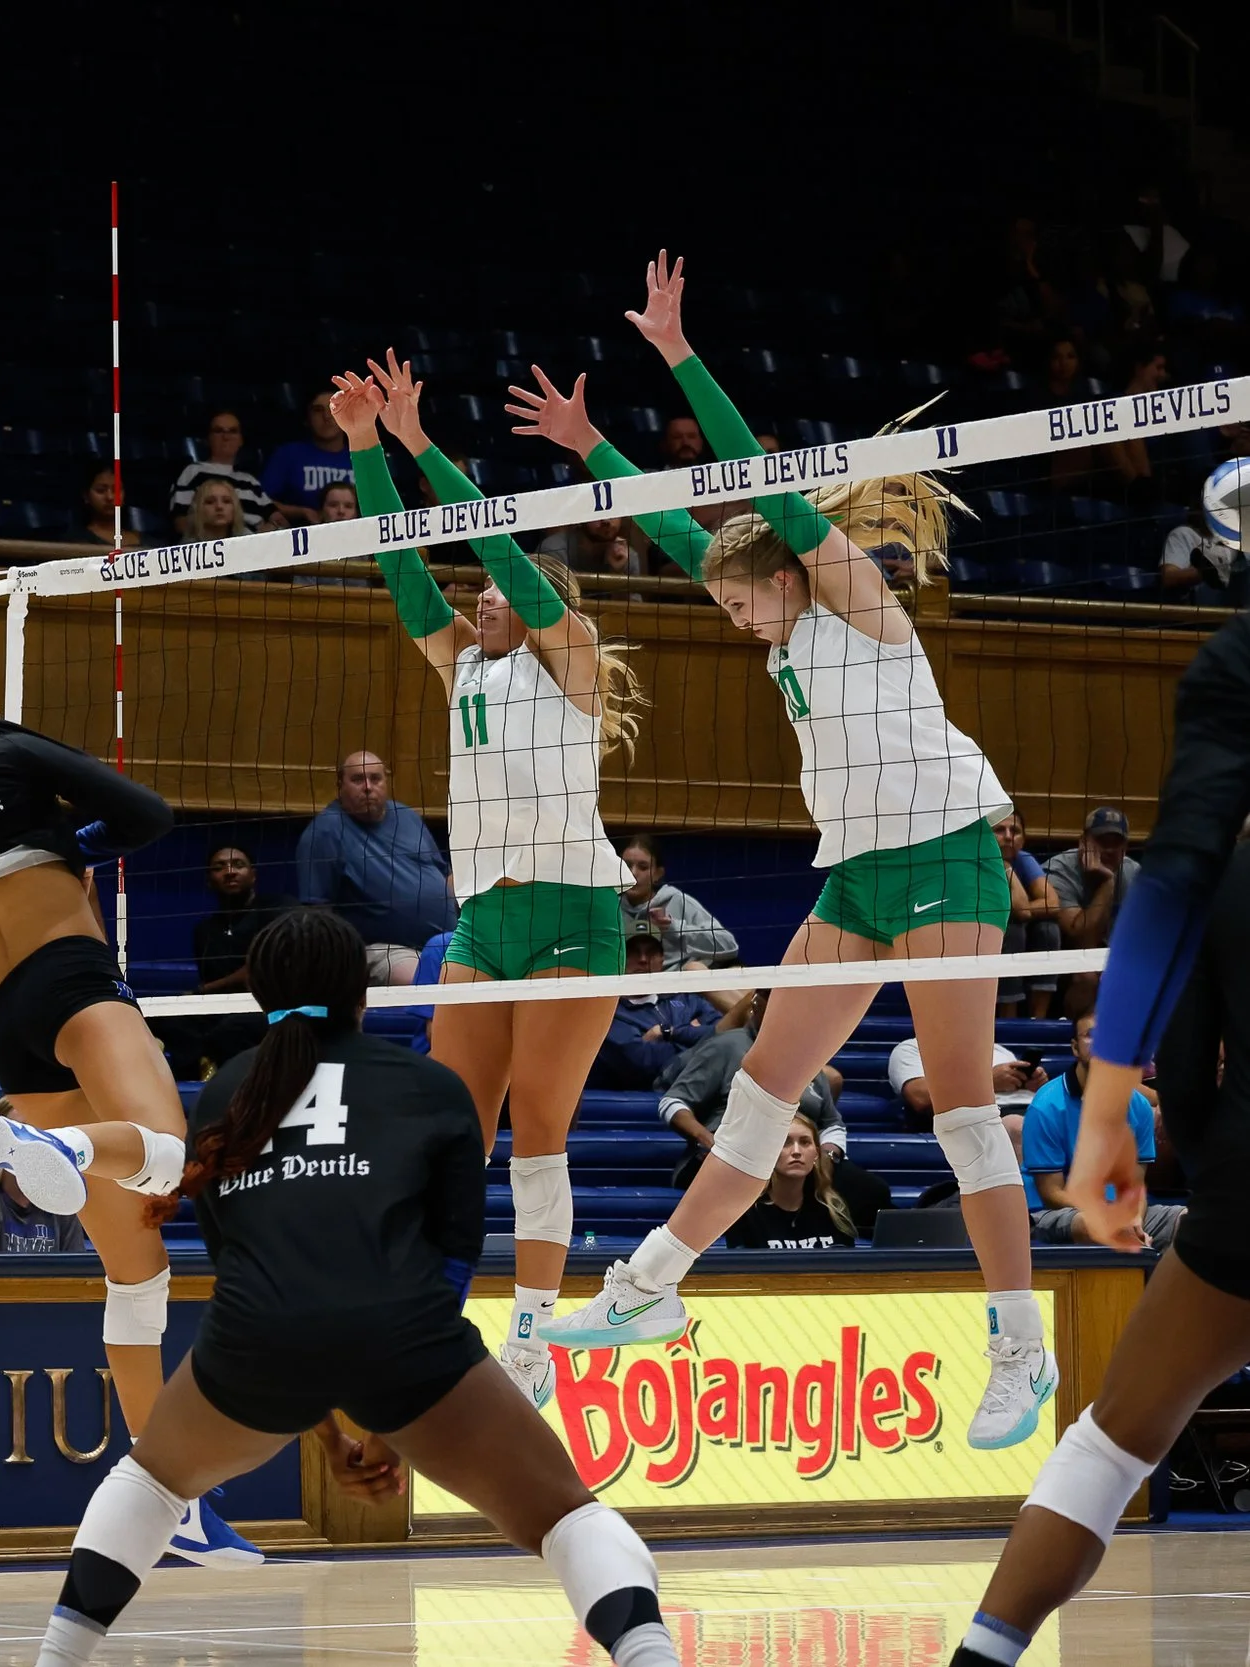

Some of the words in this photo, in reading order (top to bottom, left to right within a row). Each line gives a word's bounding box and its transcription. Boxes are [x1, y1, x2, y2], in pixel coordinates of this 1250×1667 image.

[1048, 400, 1118, 441] BLUE
[1133, 382, 1230, 427] DEVILS
[303, 465, 355, 491] DUK
[690, 459, 751, 497] BLUE
[764, 444, 848, 485] DEVILS
[379, 509, 431, 544] BLUE
[441, 496, 517, 534] DEVILS
[100, 551, 150, 581] BLUE
[158, 540, 225, 575] DEVILS
[459, 693, 489, 748] 11
[218, 1166, 274, 1198] Blue
[281, 1152, 371, 1181] Devils
[547, 1317, 943, 1493] Bojangles
